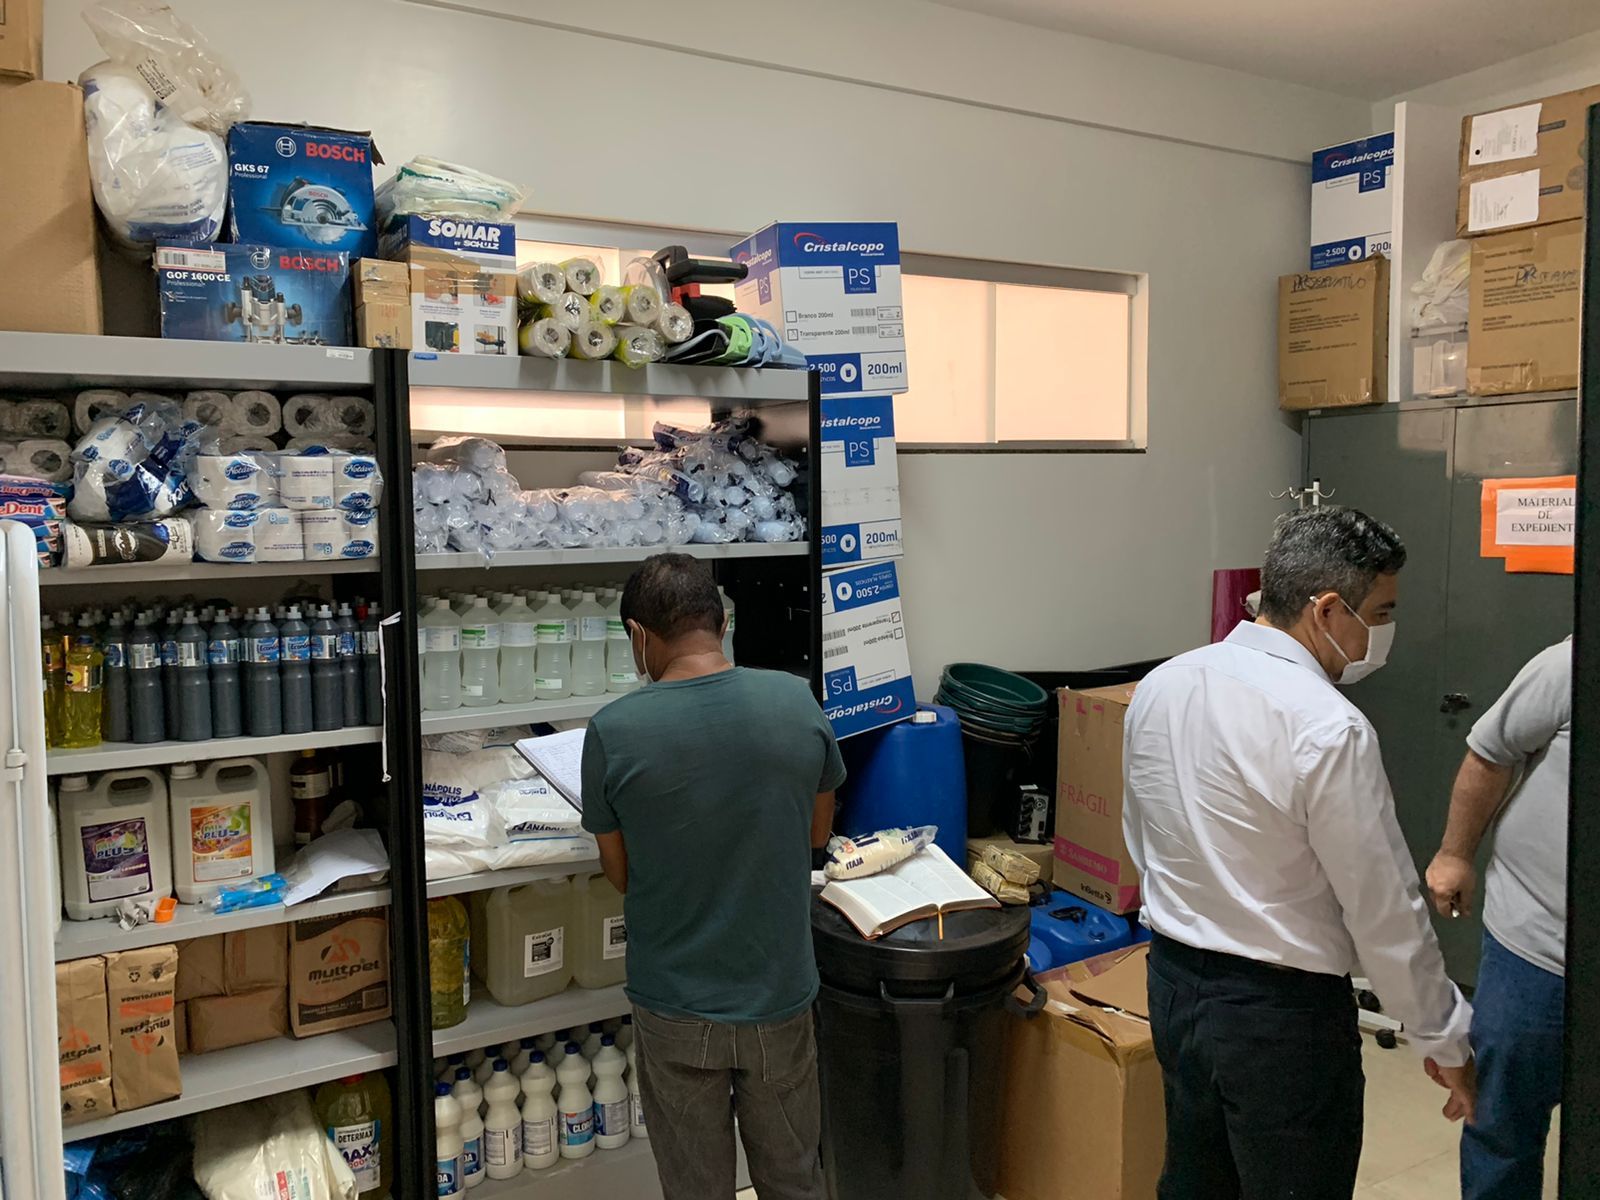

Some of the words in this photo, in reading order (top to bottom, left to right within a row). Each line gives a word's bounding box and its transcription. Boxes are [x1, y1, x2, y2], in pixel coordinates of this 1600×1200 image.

[305, 142, 365, 163] BOSCH
[1330, 147, 1394, 169] Cristalcopo
[234, 163, 255, 173] GKS
[258, 165, 269, 173] 67
[1363, 170, 1381, 186] PS
[308, 190, 329, 198] BOSCH
[428, 220, 501, 242] SOMAR
[463, 240, 499, 250] SCHULZ
[804, 241, 884, 253] Cristalcopo
[1370, 242, 1391, 252] 200
[1325, 247, 1346, 257] 2.500
[279, 256, 341, 272] BOSCH
[166, 271, 188, 280] GOF
[191, 272, 216, 281] 1600
[217, 273, 231, 282] CE
[849, 268, 871, 284] PS
[760, 277, 769, 294] PS
[868, 362, 902, 375] 200ml
[850, 441, 869, 458] PS
[1518, 497, 1575, 507] MATERIAL
[0, 502, 44, 516] eDent
[1538, 510, 1552, 519] DE
[1511, 523, 1574, 532] EXPEDIENT
[866, 530, 898, 544] 200ml
[856, 585, 880, 599] 2.500
[862, 617, 891, 629] Transparente
[831, 676, 853, 695] PS
[1060, 783, 1111, 817] FRÁGIL
[203, 829, 240, 839] PLUS
[97, 847, 135, 858] PLUS
[338, 1130, 373, 1143] DETERMAX
